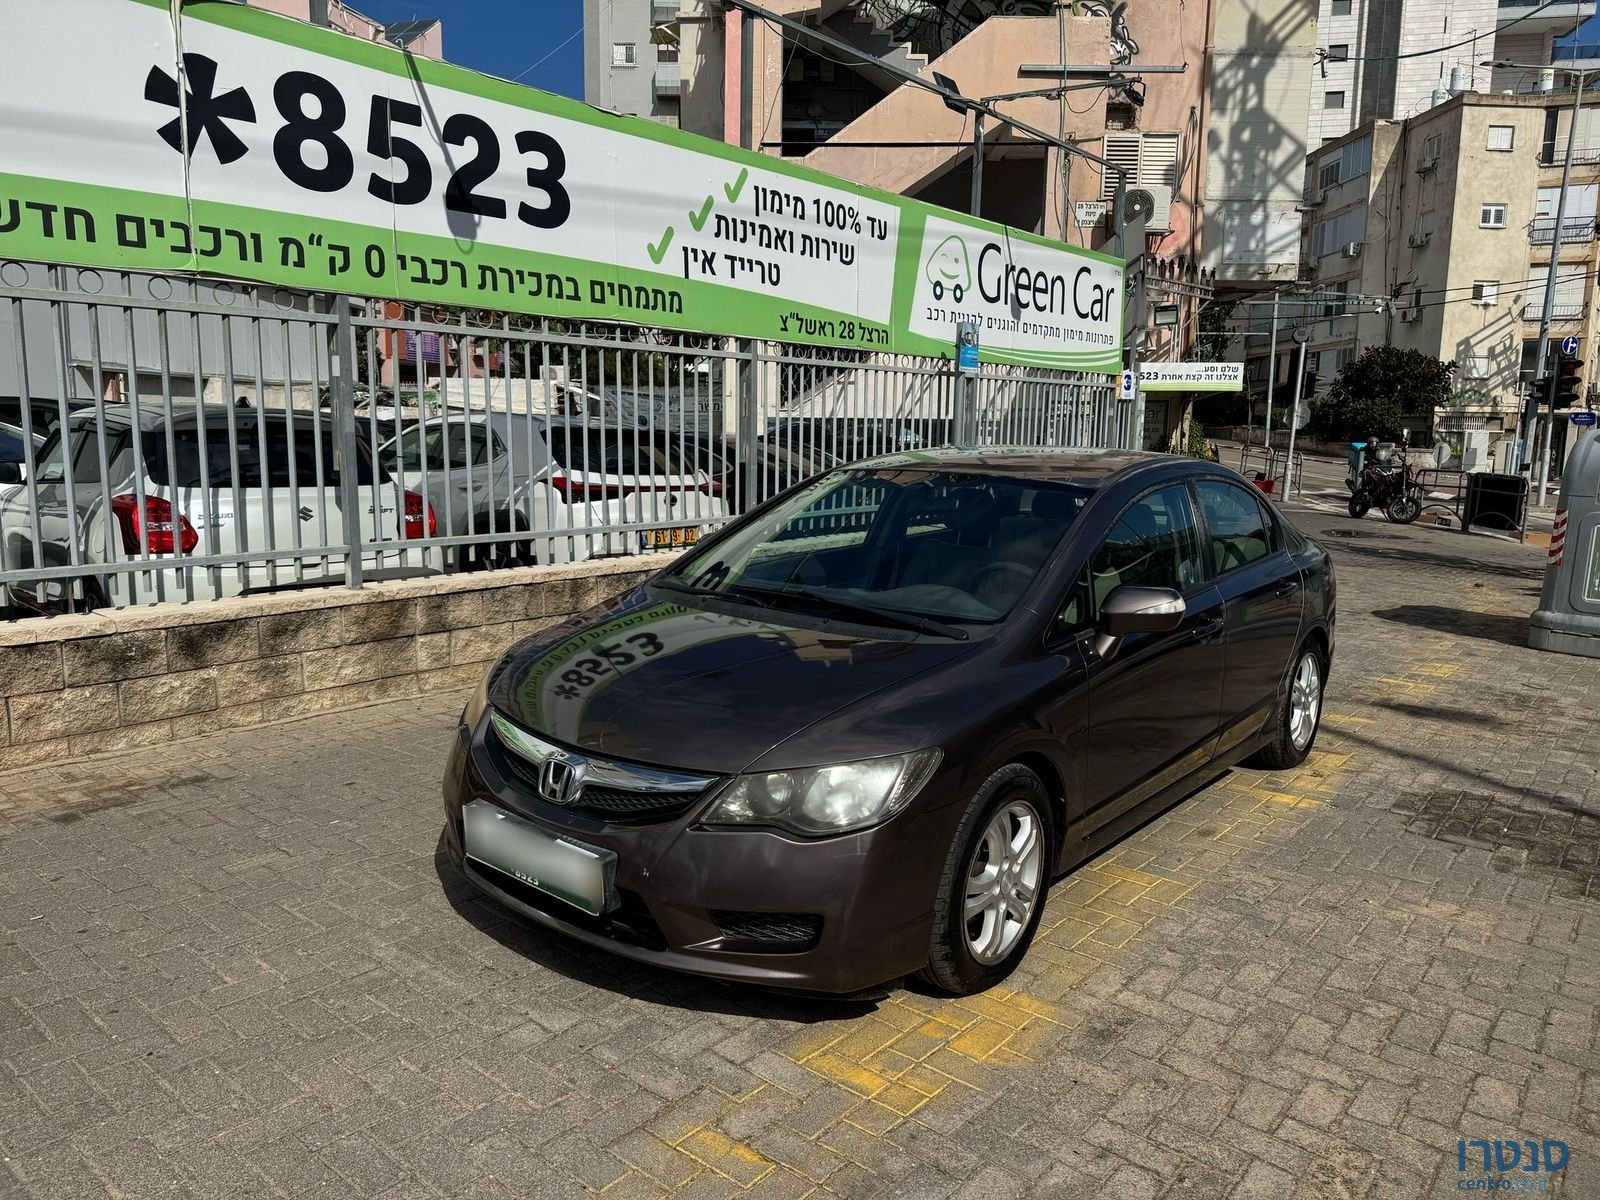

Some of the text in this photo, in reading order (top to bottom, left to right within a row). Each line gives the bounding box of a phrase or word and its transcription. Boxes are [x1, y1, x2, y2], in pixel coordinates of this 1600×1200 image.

[753, 185, 887, 241] עד 100% מימון
[116, 213, 263, 263] ורכבים
[714, 214, 855, 266] שירות ואמינות
[364, 244, 386, 278] 0
[397, 253, 467, 288] רכבי
[682, 246, 781, 287] טרייד אין
[477, 264, 582, 302] במכירת
[977, 242, 1115, 323] Green Car
[589, 279, 683, 314] מתמחים
[926, 307, 946, 323] רכב
[986, 316, 1020, 333] והוגנים
[838, 320, 855, 341] 28
[858, 322, 889, 345] הרצל
[1022, 322, 1061, 340] מתקדמים
[1063, 329, 1083, 342] מימון
[1085, 330, 1114, 346] פתרונות
[1160, 373, 1183, 381] אחרת
[1184, 373, 1203, 382] קצת
[1204, 373, 1214, 381] זה
[1215, 373, 1238, 381] אצלנו
[1220, 365, 1239, 373] שלם
